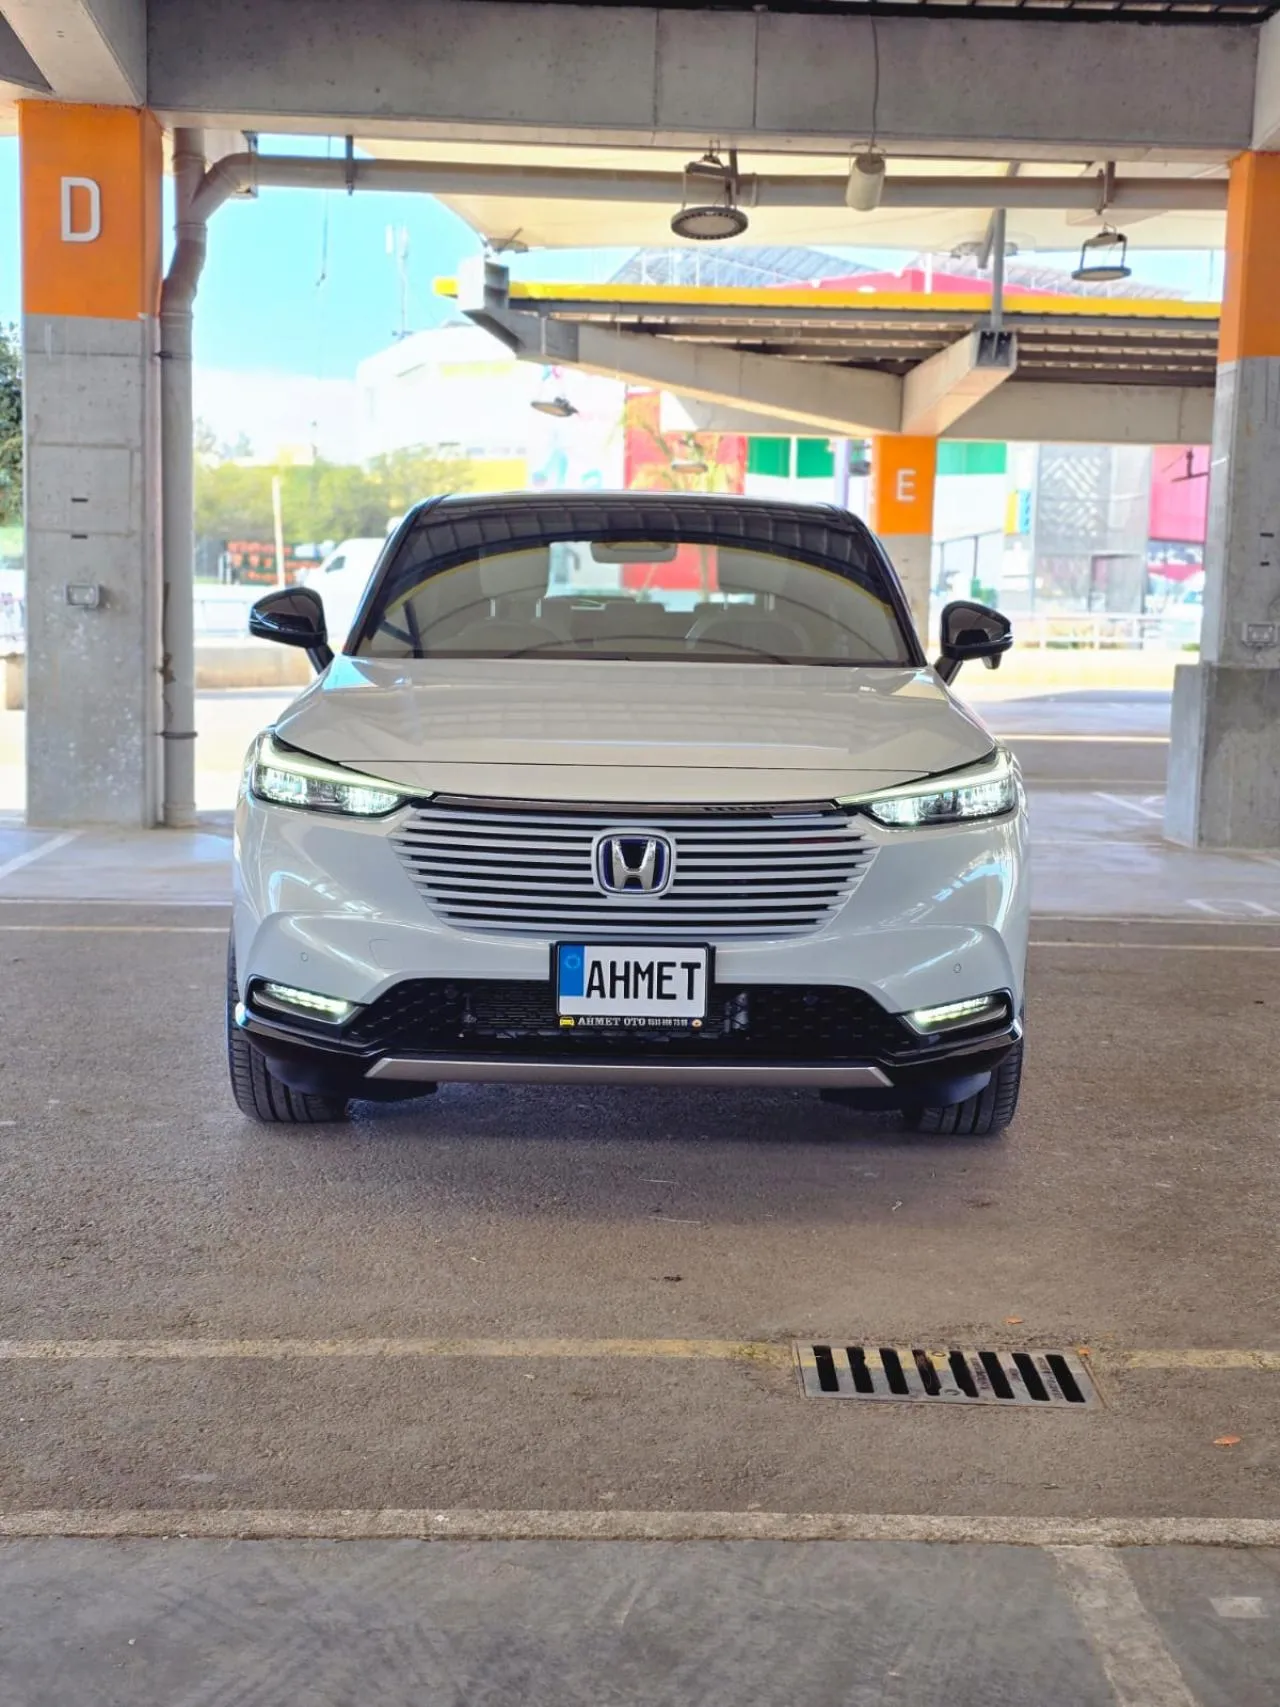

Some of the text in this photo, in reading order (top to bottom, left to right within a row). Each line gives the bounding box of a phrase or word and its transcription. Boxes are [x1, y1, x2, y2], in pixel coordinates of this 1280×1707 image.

[60, 176, 101, 242] D
[896, 468, 917, 502] E
[586, 960, 701, 1000] AHMET
[577, 1017, 621, 1026] AHMET
[624, 1018, 646, 1026] OTO
